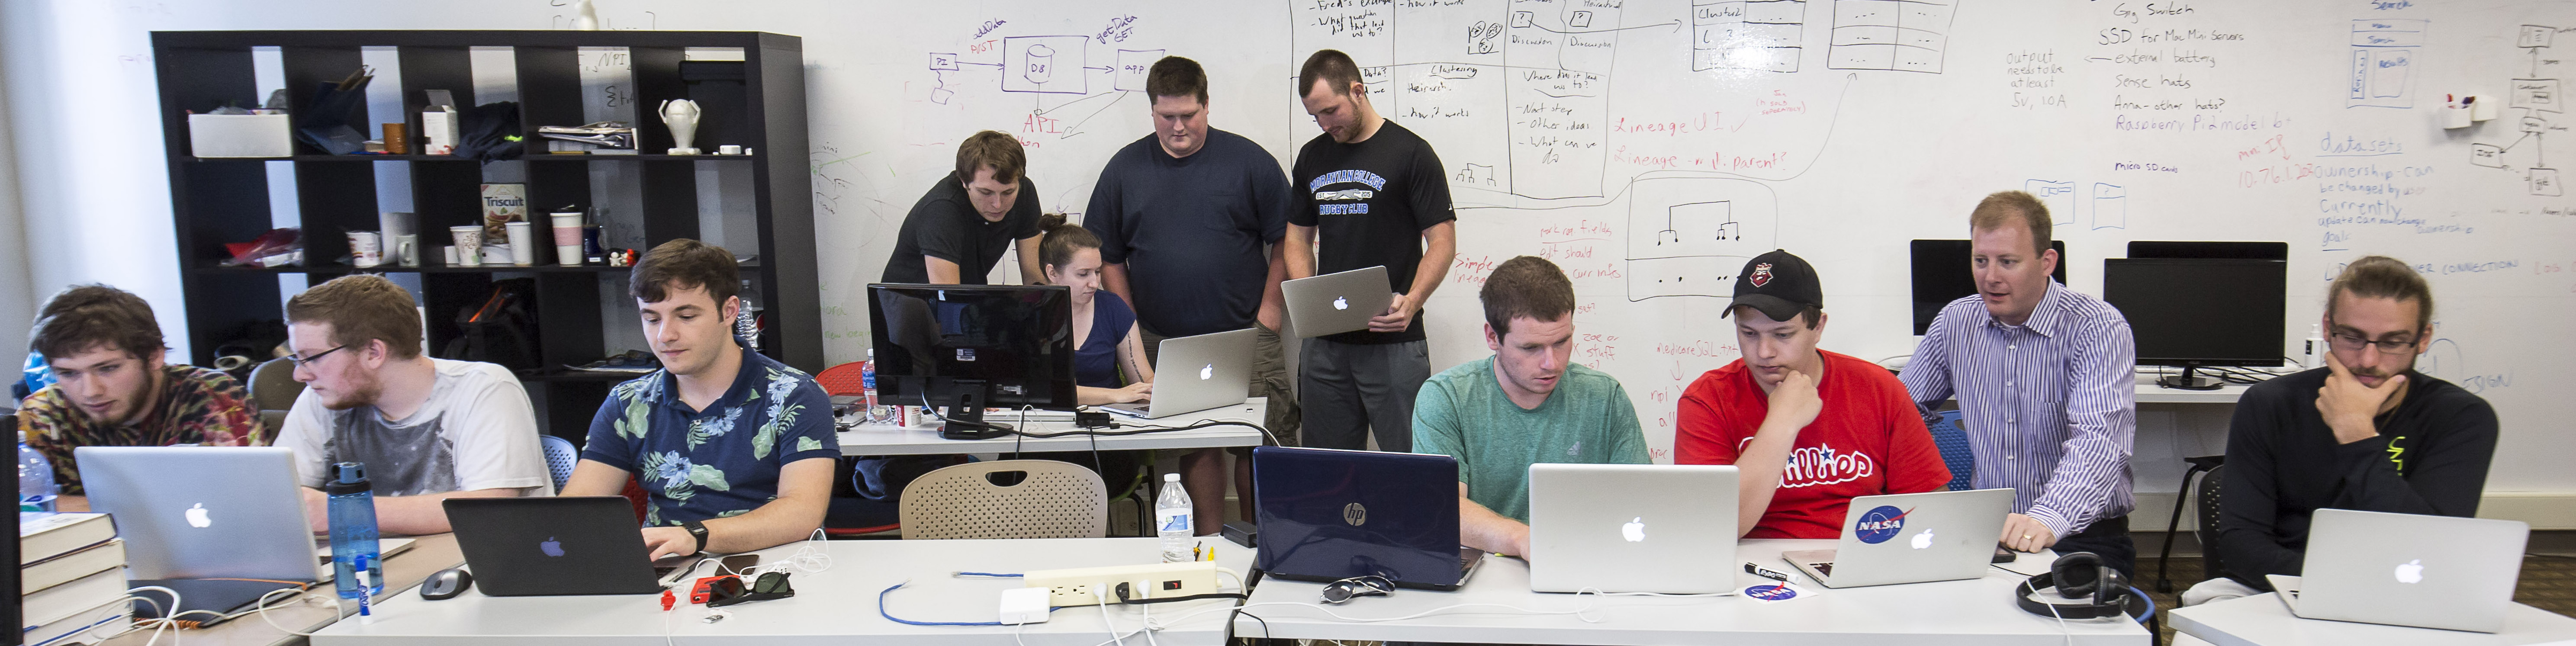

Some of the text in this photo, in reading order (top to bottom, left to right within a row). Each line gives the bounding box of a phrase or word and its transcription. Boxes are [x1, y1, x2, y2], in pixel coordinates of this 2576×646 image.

[2099, 28, 2132, 45] SSD
[1031, 64, 1045, 73] DB
[1023, 113, 1062, 133] API
[1310, 170, 1386, 194] MORAVIAN COLLEGE
[484, 196, 524, 206] Triscuit
[1319, 203, 1368, 215] RUGBY CLUB
[1347, 503, 1365, 525] hp
[1858, 521, 1901, 530] NASA
[1751, 588, 1792, 598] NASA
